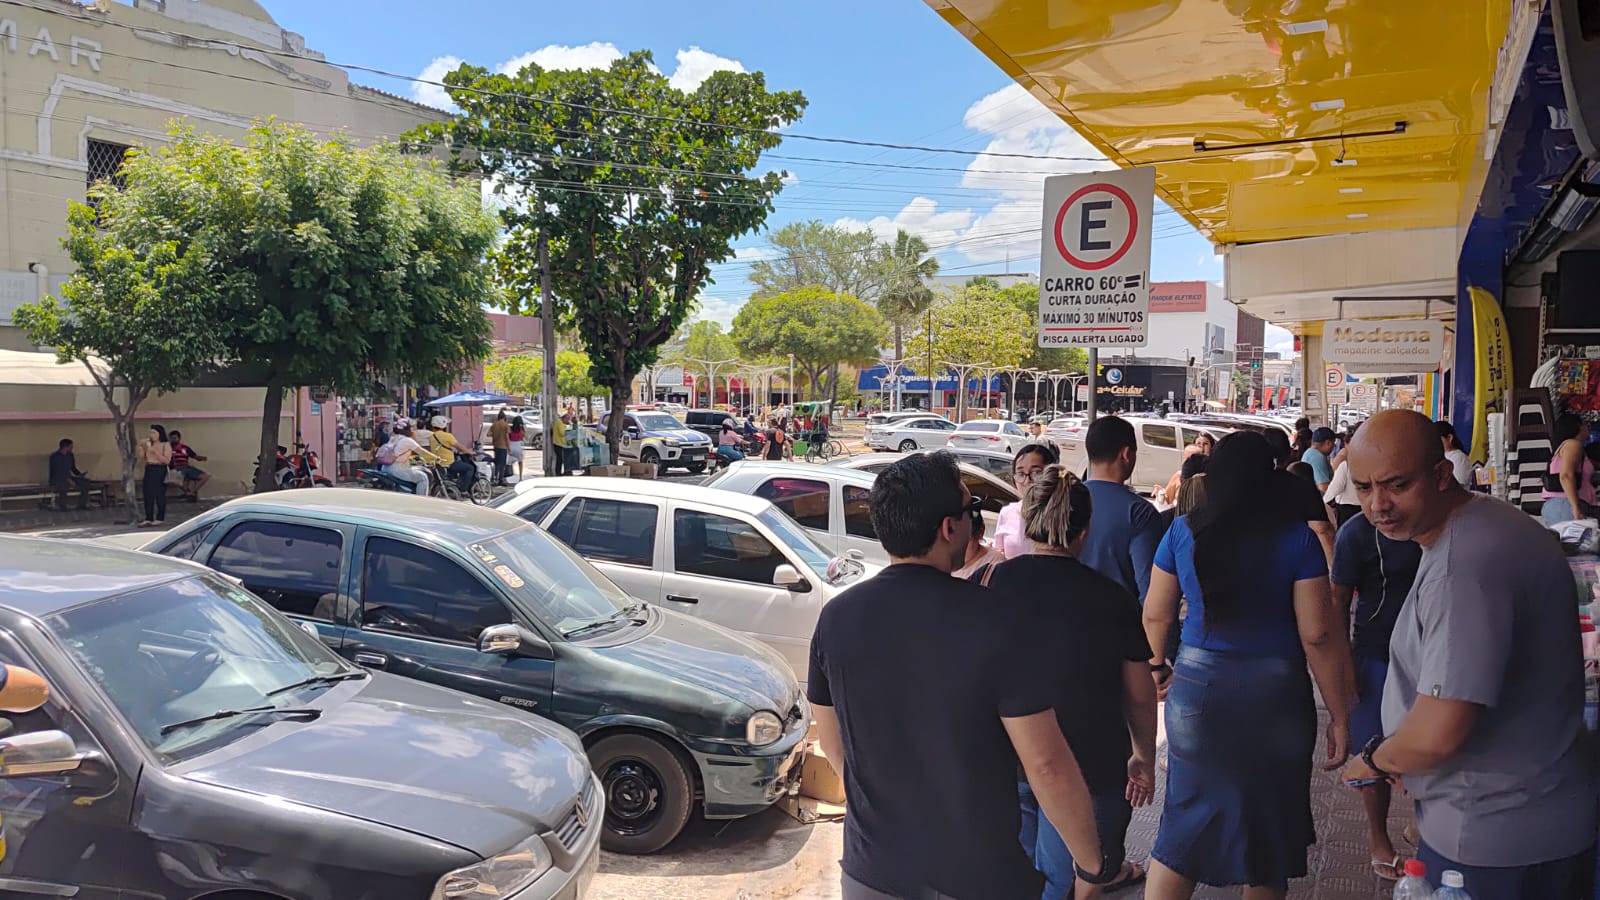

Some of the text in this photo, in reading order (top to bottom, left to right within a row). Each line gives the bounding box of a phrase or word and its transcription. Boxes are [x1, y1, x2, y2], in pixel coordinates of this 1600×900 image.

[1080, 201, 1112, 251] E
[1045, 277, 1094, 292] CARRO
[1048, 295, 1081, 306] CURTA
[1085, 291, 1136, 306] DURAÇÃO
[1083, 312, 1095, 323] 30
[1098, 311, 1143, 323] MINUTOS
[1043, 334, 1144, 343] PISCA ALERTA LIGADO
[1334, 326, 1431, 343] Moderna
[1334, 346, 1430, 355] magazine calçados
[1328, 372, 1337, 383] E
